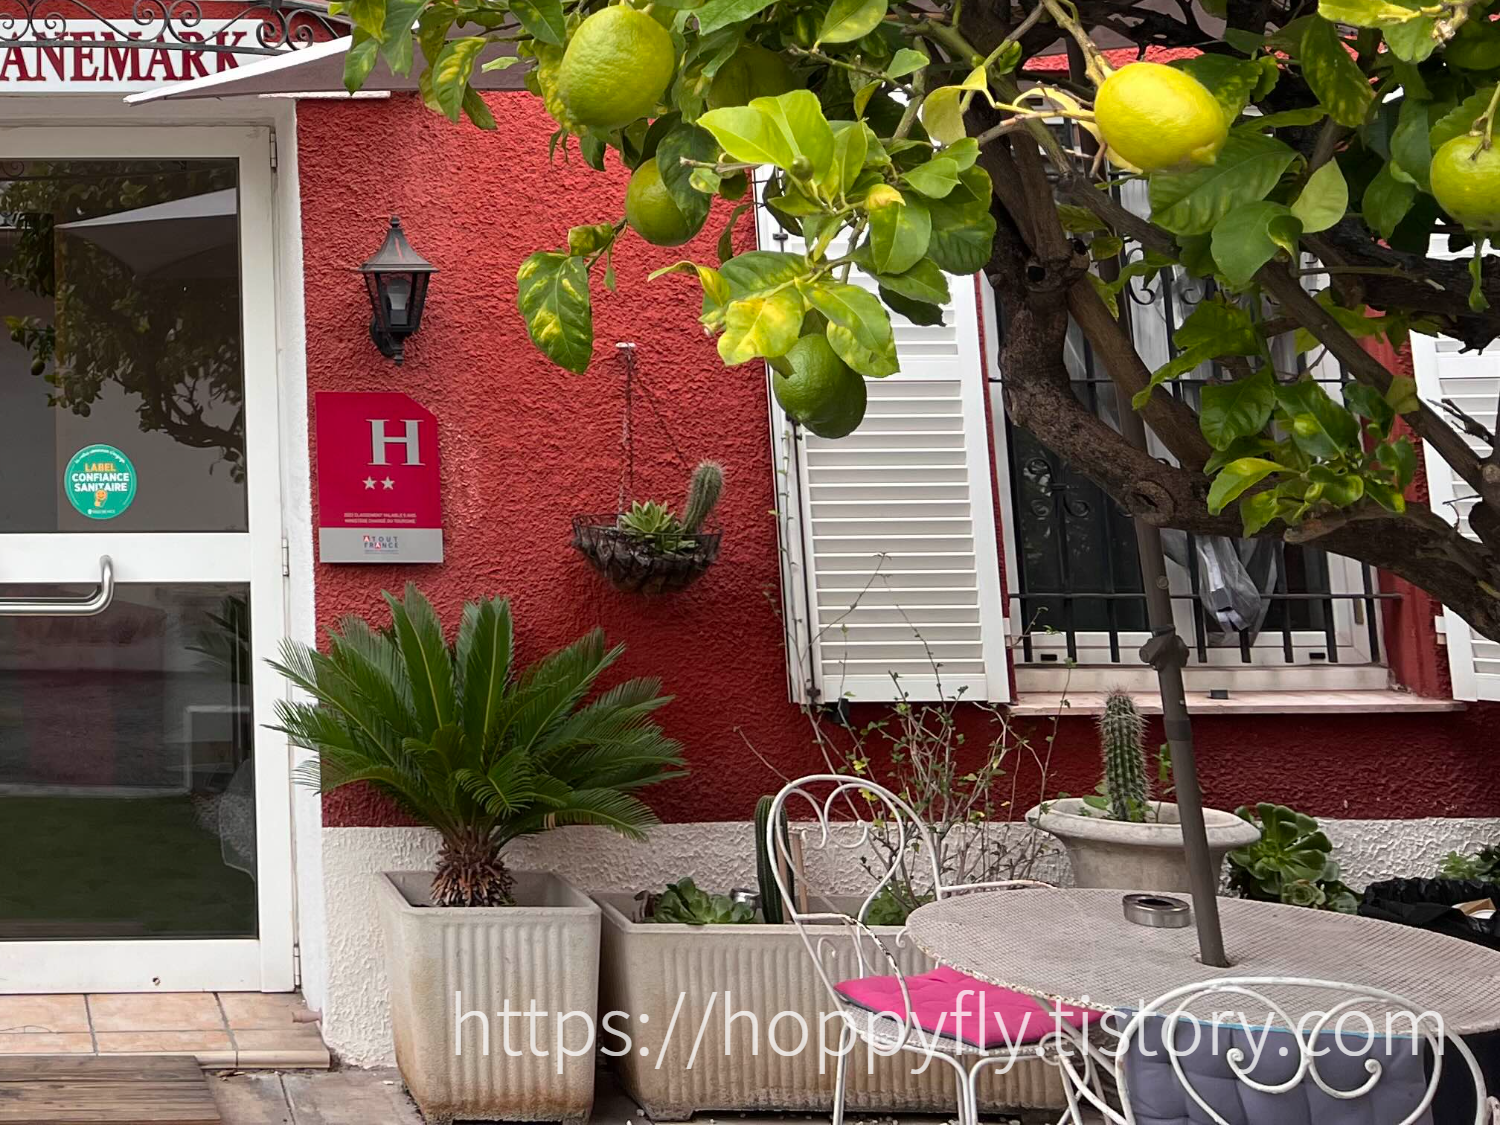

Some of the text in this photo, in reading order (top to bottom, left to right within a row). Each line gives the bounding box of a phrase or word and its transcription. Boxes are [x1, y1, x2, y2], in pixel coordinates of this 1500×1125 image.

[365, 418, 426, 466] H
[84, 462, 117, 472] LABEL
[71, 472, 130, 482] CONFIANCE
[74, 482, 128, 492] SANITAIRE
